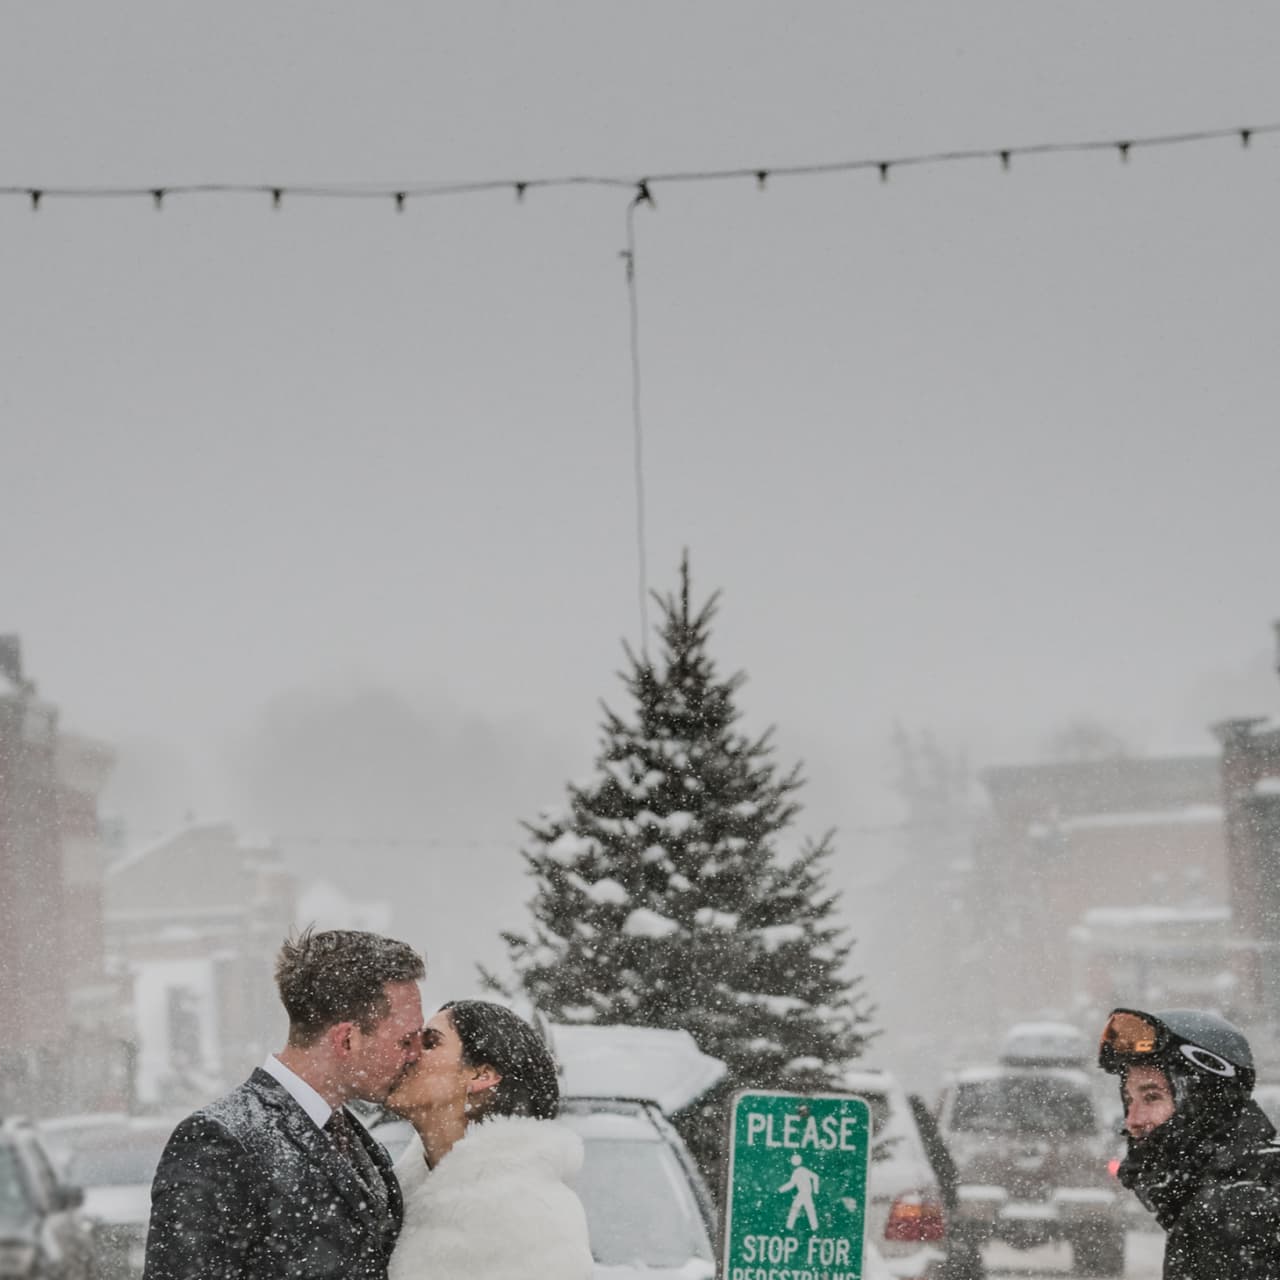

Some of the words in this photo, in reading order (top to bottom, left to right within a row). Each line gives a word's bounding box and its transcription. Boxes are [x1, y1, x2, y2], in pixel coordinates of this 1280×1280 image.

[747, 1111, 857, 1151] PLEASE
[742, 1235, 799, 1264] STOP
[807, 1237, 851, 1266] FOR
